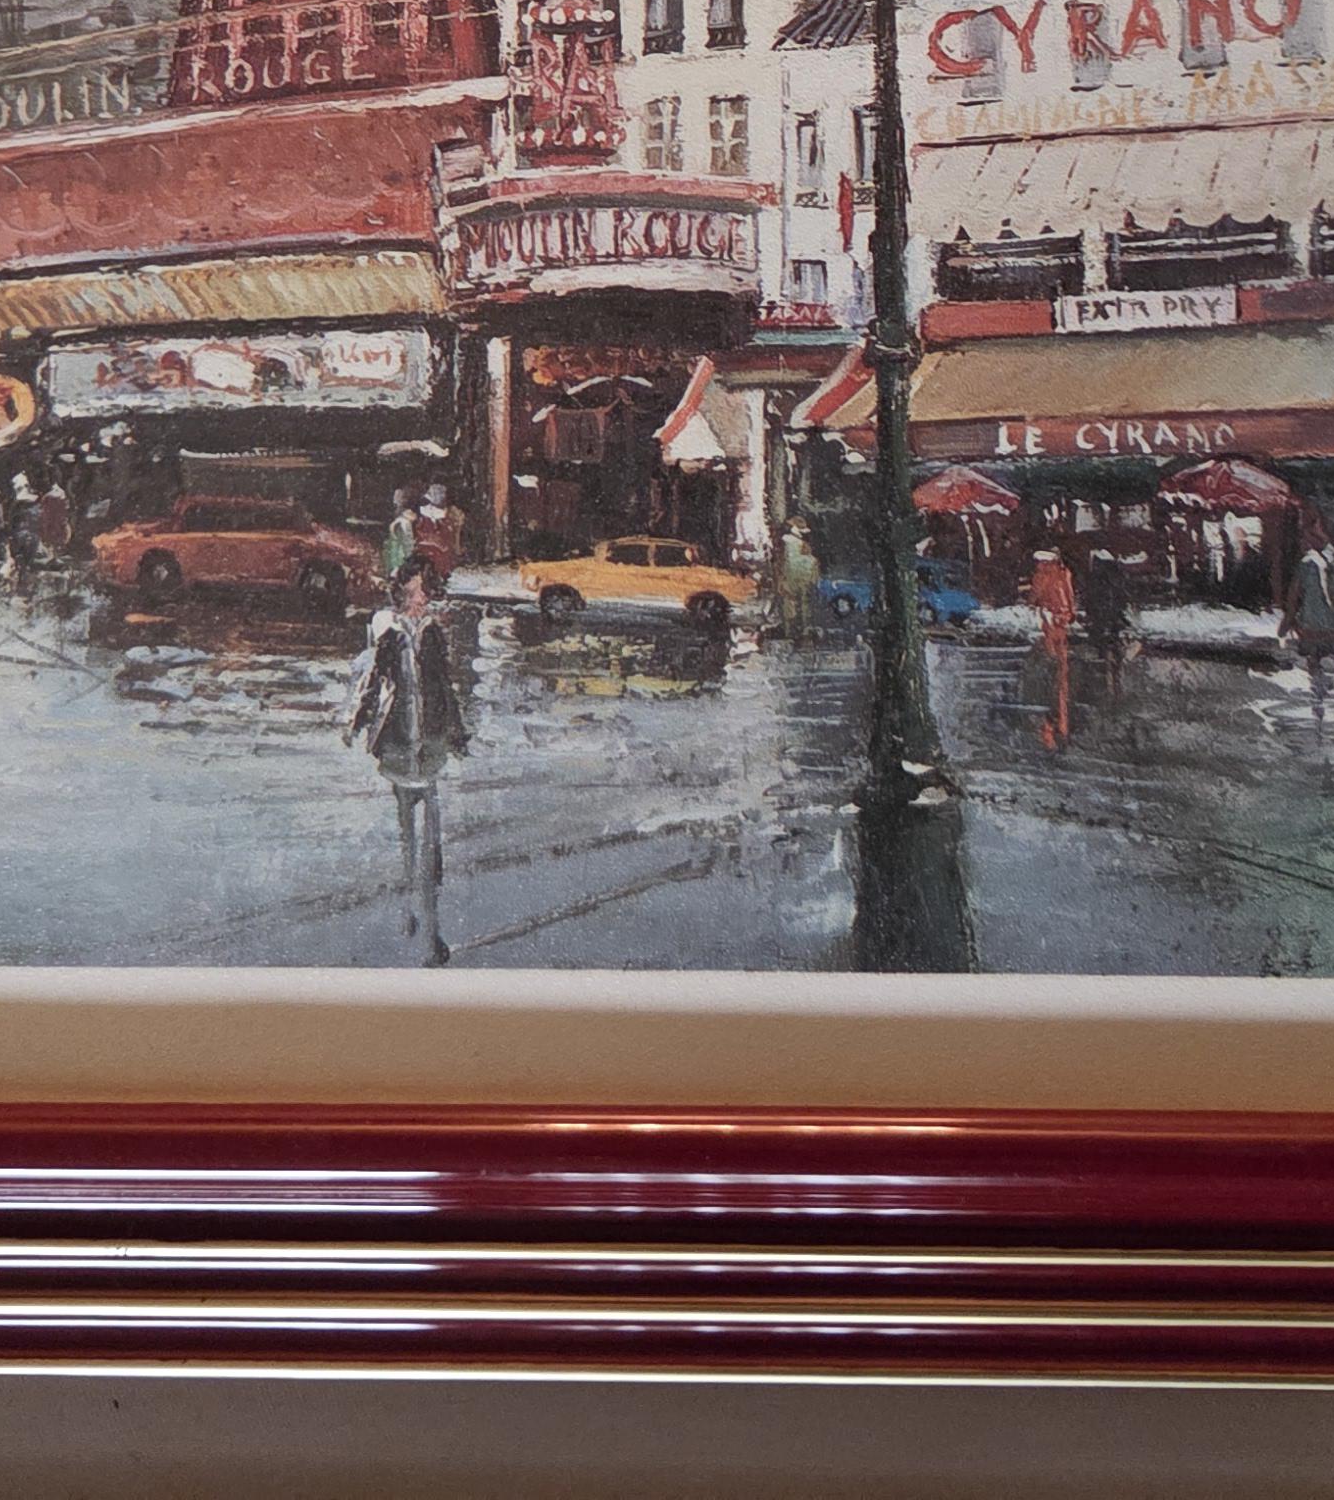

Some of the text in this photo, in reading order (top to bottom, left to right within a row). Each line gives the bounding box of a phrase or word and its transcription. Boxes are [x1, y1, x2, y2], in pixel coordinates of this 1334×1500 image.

[191, 44, 375, 102] ROUGE
[467, 205, 747, 268] MOULIN ROUGE
[994, 419, 1235, 455] LE CYRANO
